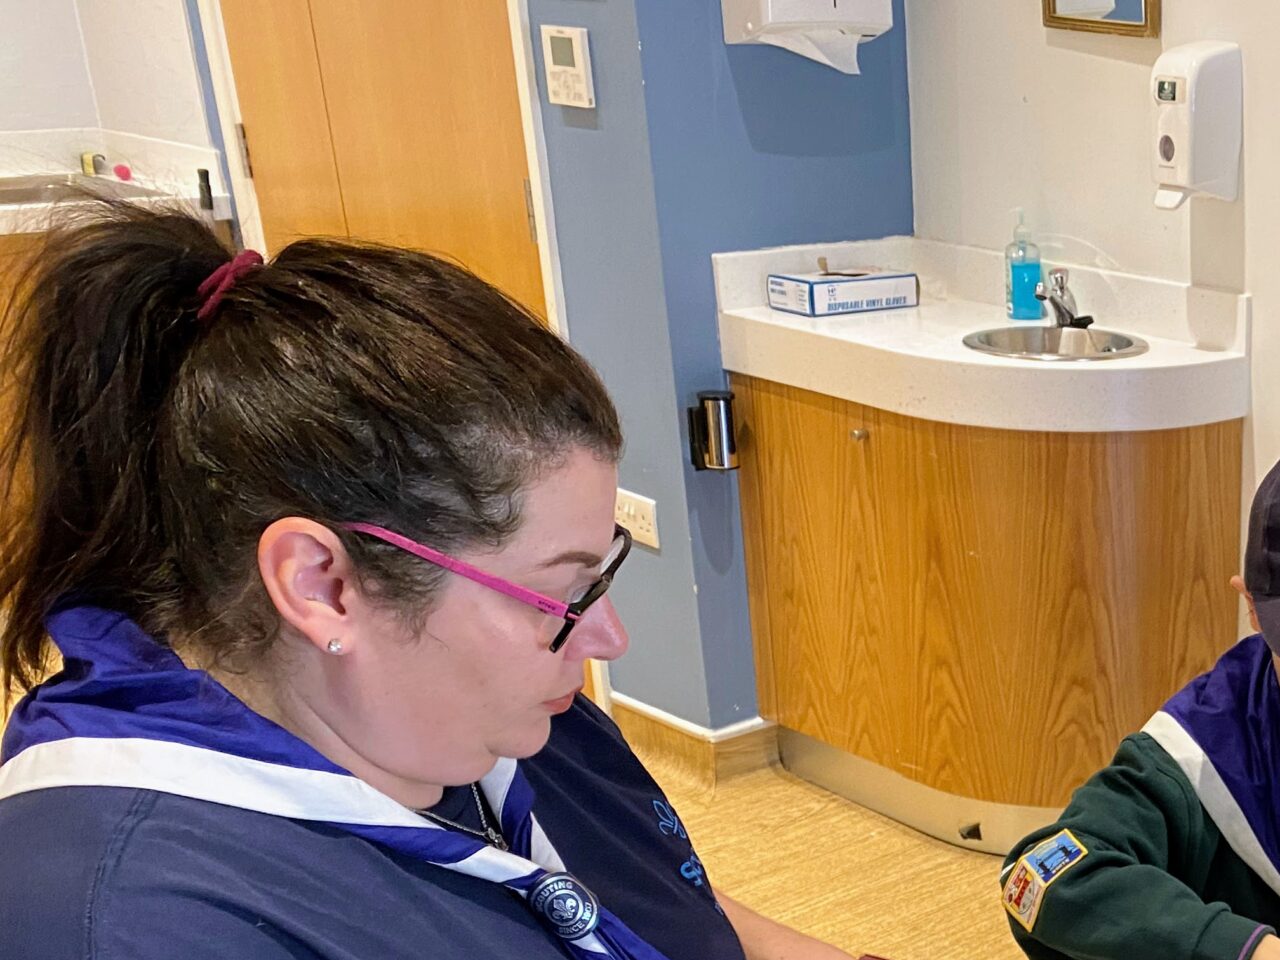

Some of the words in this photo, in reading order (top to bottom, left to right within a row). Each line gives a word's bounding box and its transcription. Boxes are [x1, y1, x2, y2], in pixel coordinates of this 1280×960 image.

[827, 300, 864, 311] DISPOSABLE
[865, 298, 883, 308] VINYL
[885, 296, 907, 306] GLOVES
[535, 881, 573, 912] SCOUTING
[558, 920, 586, 934] SINCE
